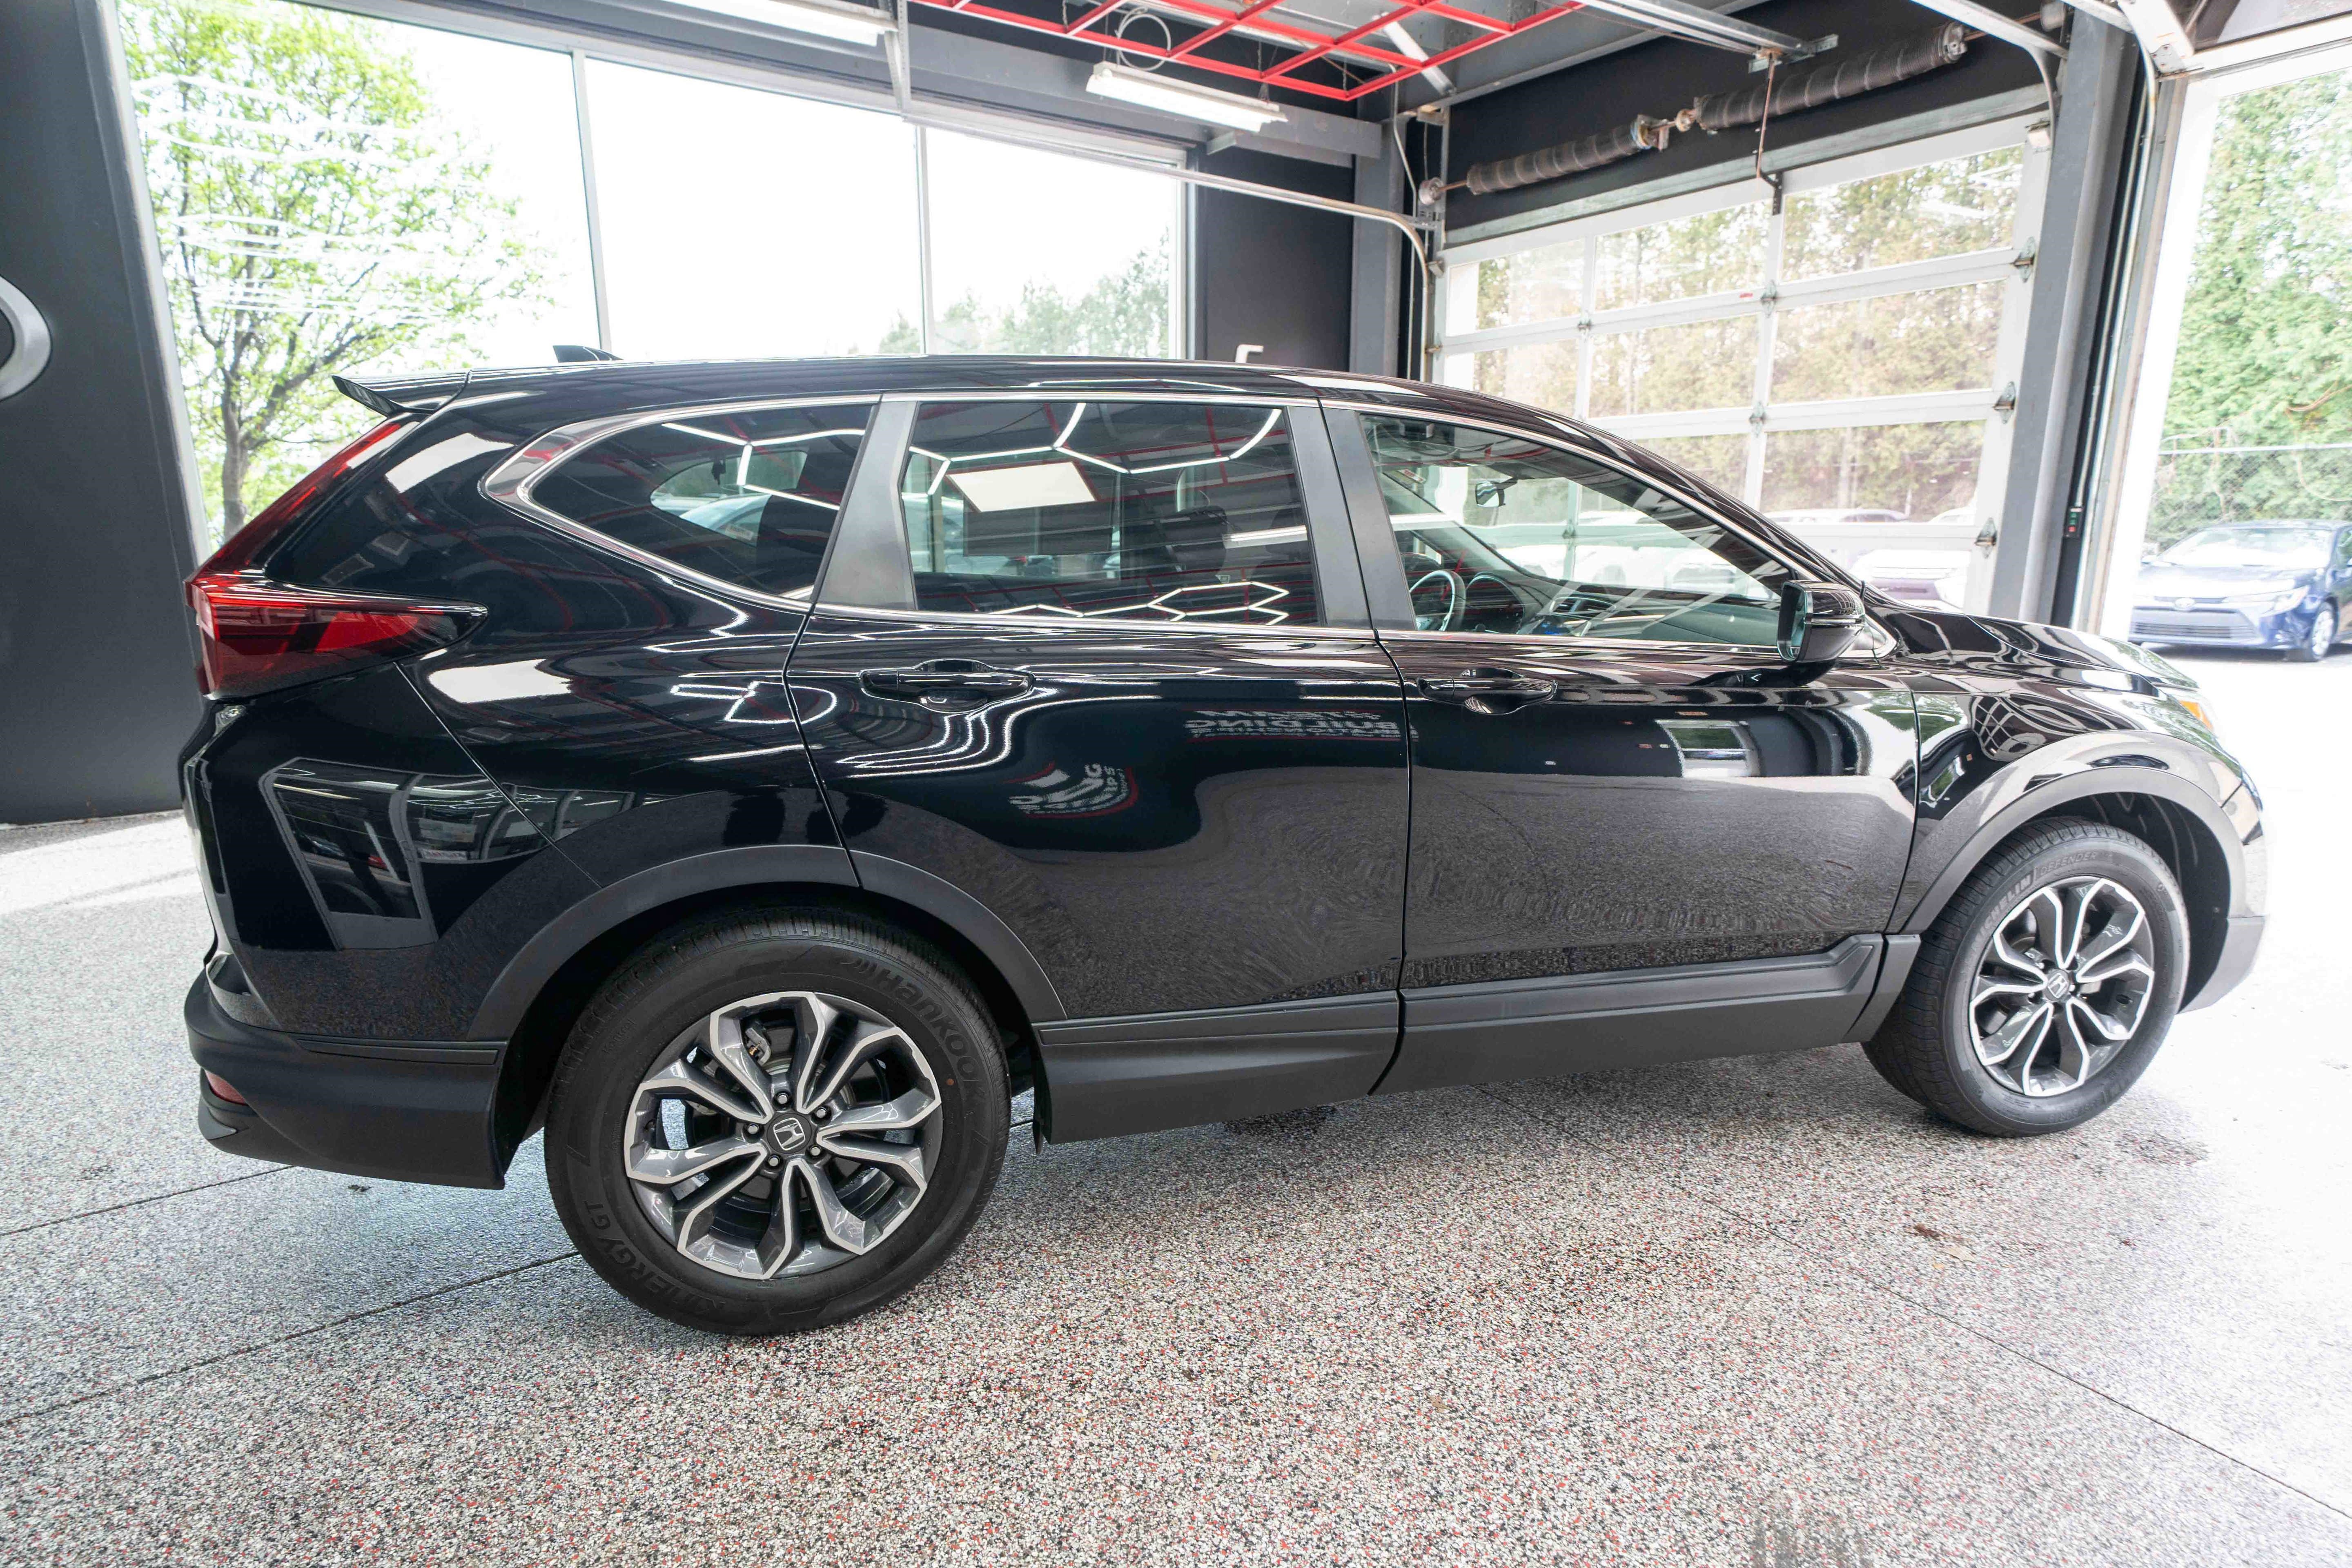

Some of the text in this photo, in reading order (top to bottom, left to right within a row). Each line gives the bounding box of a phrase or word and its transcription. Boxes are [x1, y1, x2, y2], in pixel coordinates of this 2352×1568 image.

[2042, 852, 2096, 875] DEFENDER
[1971, 875, 2032, 953] MICHELIN
[874, 967, 983, 1098] Hankook
[584, 1200, 611, 1230] GT
